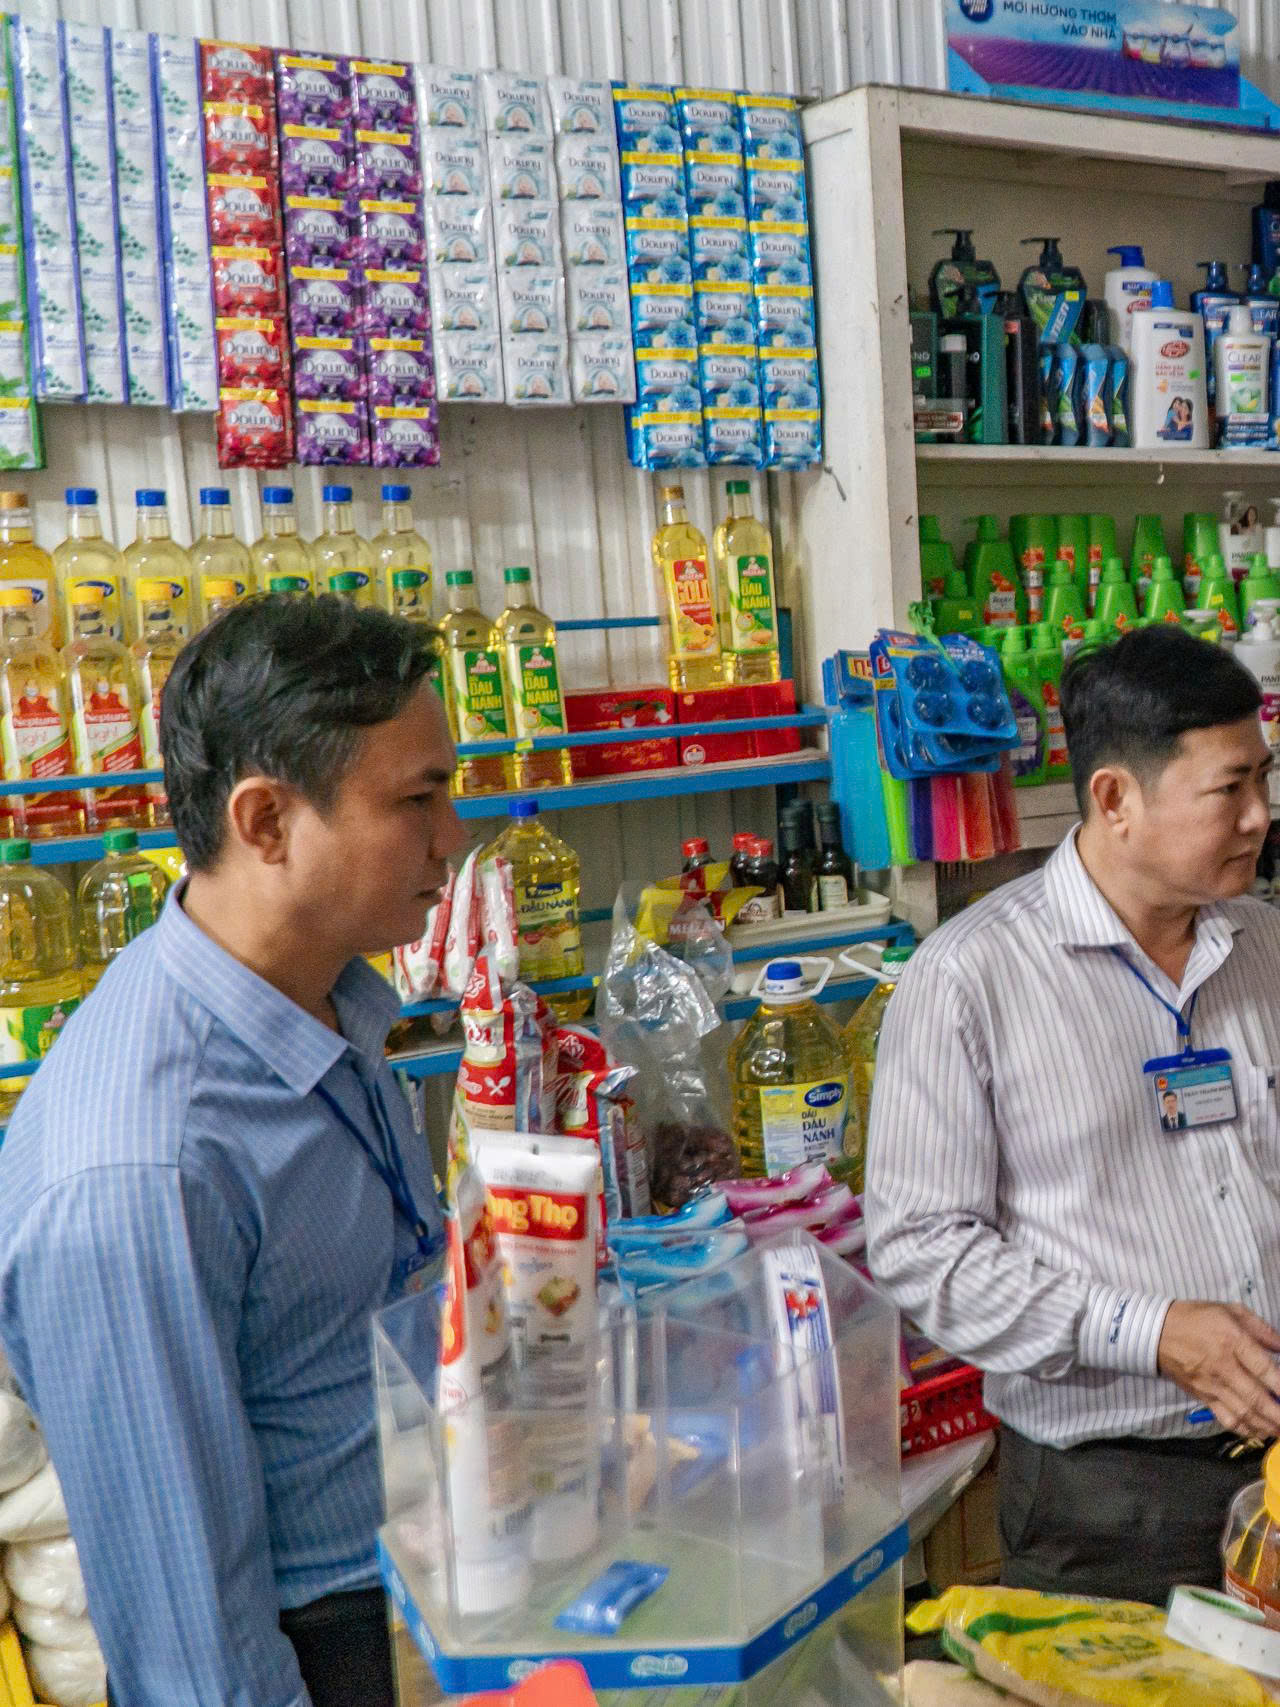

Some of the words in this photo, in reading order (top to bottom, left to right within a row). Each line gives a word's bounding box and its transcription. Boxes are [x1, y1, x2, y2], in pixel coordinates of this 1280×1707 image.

[207, 55, 263, 78] Downy
[289, 79, 341, 99] Downy
[358, 82, 410, 102] Downy
[431, 83, 471, 99] Downy
[498, 90, 537, 106] Downy
[563, 91, 602, 106] Downy
[628, 106, 668, 123] Downy
[690, 106, 731, 123] Downy
[751, 113, 788, 129] Downy
[213, 124, 267, 147] Downy
[291, 149, 343, 170] Downy
[365, 153, 415, 173] Downy
[436, 152, 475, 168] Downy
[503, 156, 542, 172] Downy
[568, 157, 607, 173] Downy
[635, 172, 675, 189] Downy
[696, 171, 735, 188] Downy
[756, 177, 793, 193] Downy
[217, 199, 271, 221] Downy
[297, 220, 349, 241] Downy
[368, 223, 420, 243] Downy
[508, 223, 547, 238] Downy
[574, 223, 611, 238] Downy
[640, 237, 681, 253] Downy
[700, 236, 739, 252] Downy
[761, 240, 797, 257] Downy
[222, 271, 275, 291] Downy
[302, 290, 353, 310] Downy
[375, 291, 425, 311] Downy
[513, 290, 552, 306] Downy
[578, 289, 616, 304] Downy
[645, 302, 686, 319] Downy
[705, 300, 743, 317] Downy
[766, 303, 802, 320] Downy
[226, 341, 279, 361] Downy
[379, 360, 429, 380] Downy
[449, 356, 488, 372] Downy
[518, 356, 556, 371] Downy
[584, 355, 620, 369] Downy
[711, 362, 748, 379] Downy
[305, 360, 358, 382] Downy
[650, 366, 690, 383] Downy
[771, 365, 807, 382] Downy
[229, 412, 282, 432] Downy
[307, 424, 359, 444] Downy
[384, 429, 434, 448] Downy
[656, 430, 694, 447] Downy
[715, 425, 752, 442] Downy
[776, 428, 811, 443] Downy
[808, 1086, 842, 1104] Simply
